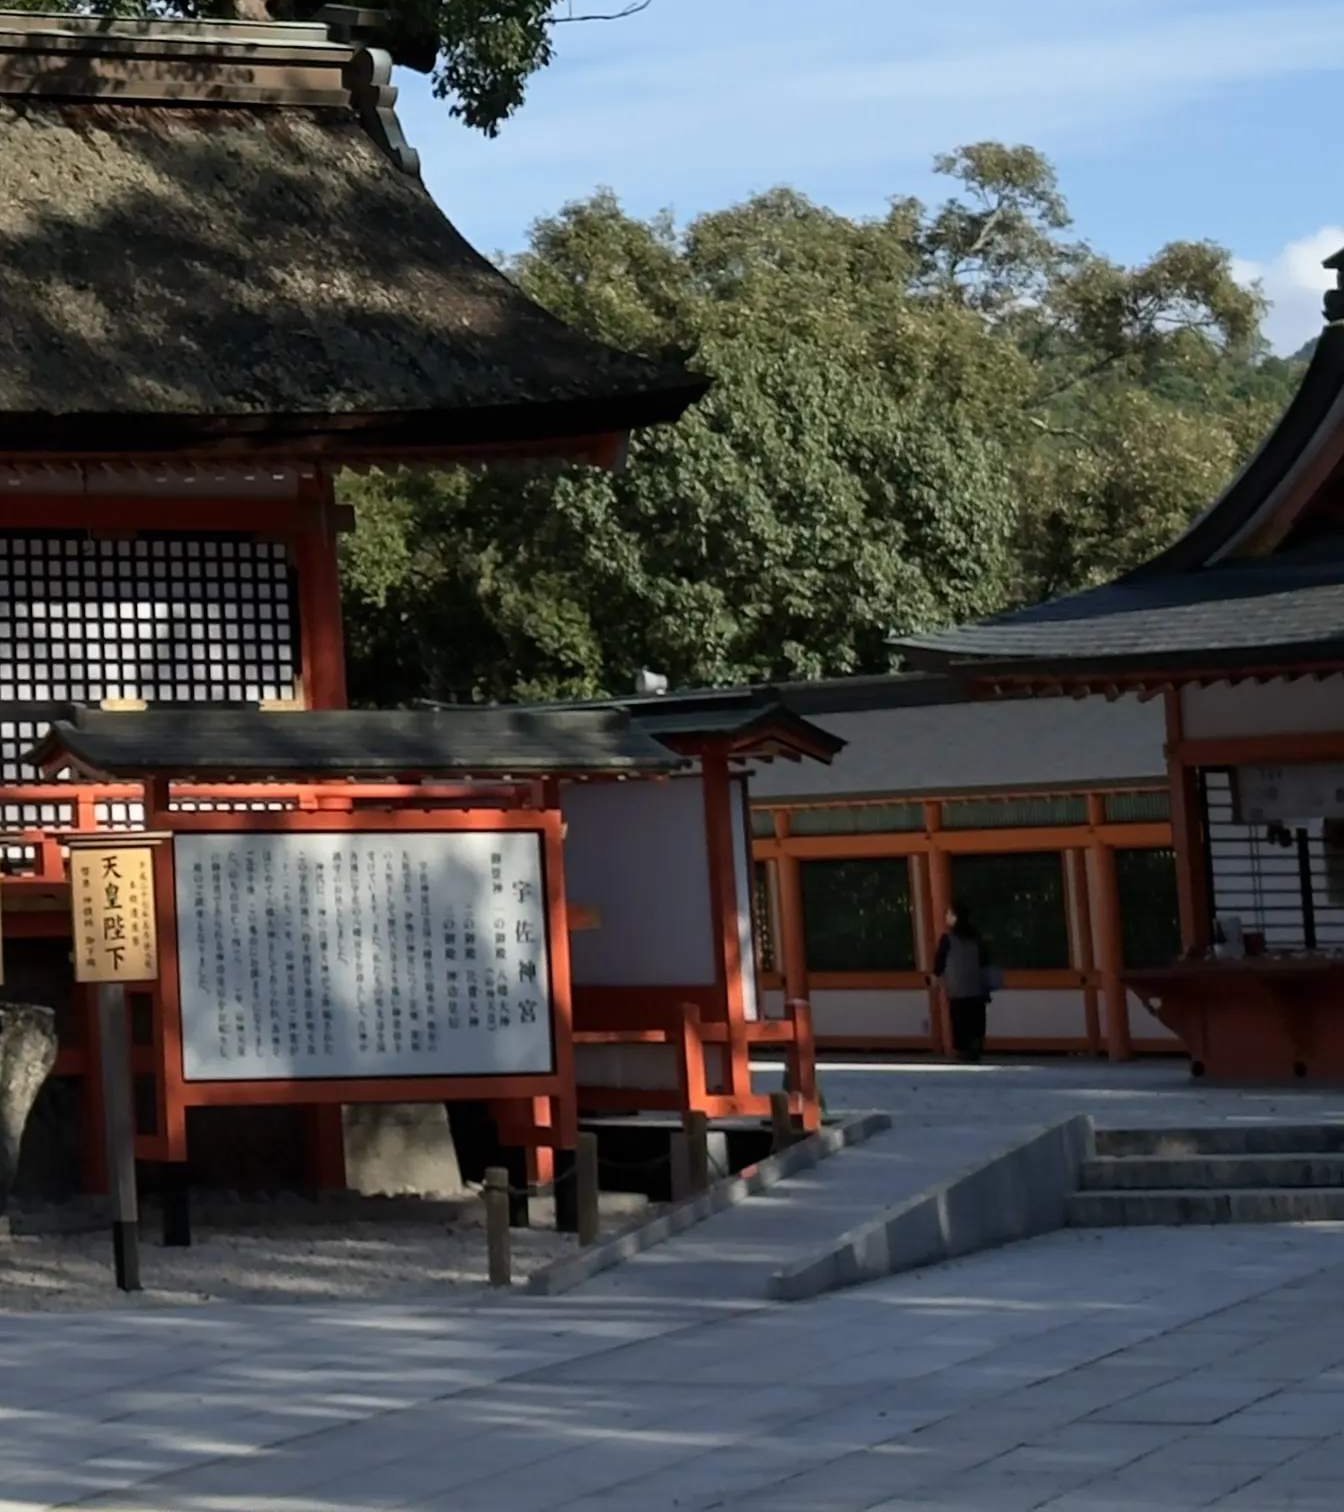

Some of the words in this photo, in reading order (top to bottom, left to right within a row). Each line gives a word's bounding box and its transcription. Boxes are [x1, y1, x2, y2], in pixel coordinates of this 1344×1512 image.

[101, 855, 126, 971] 天皇陛下
[512, 879, 538, 1024] 宇佐神宮
